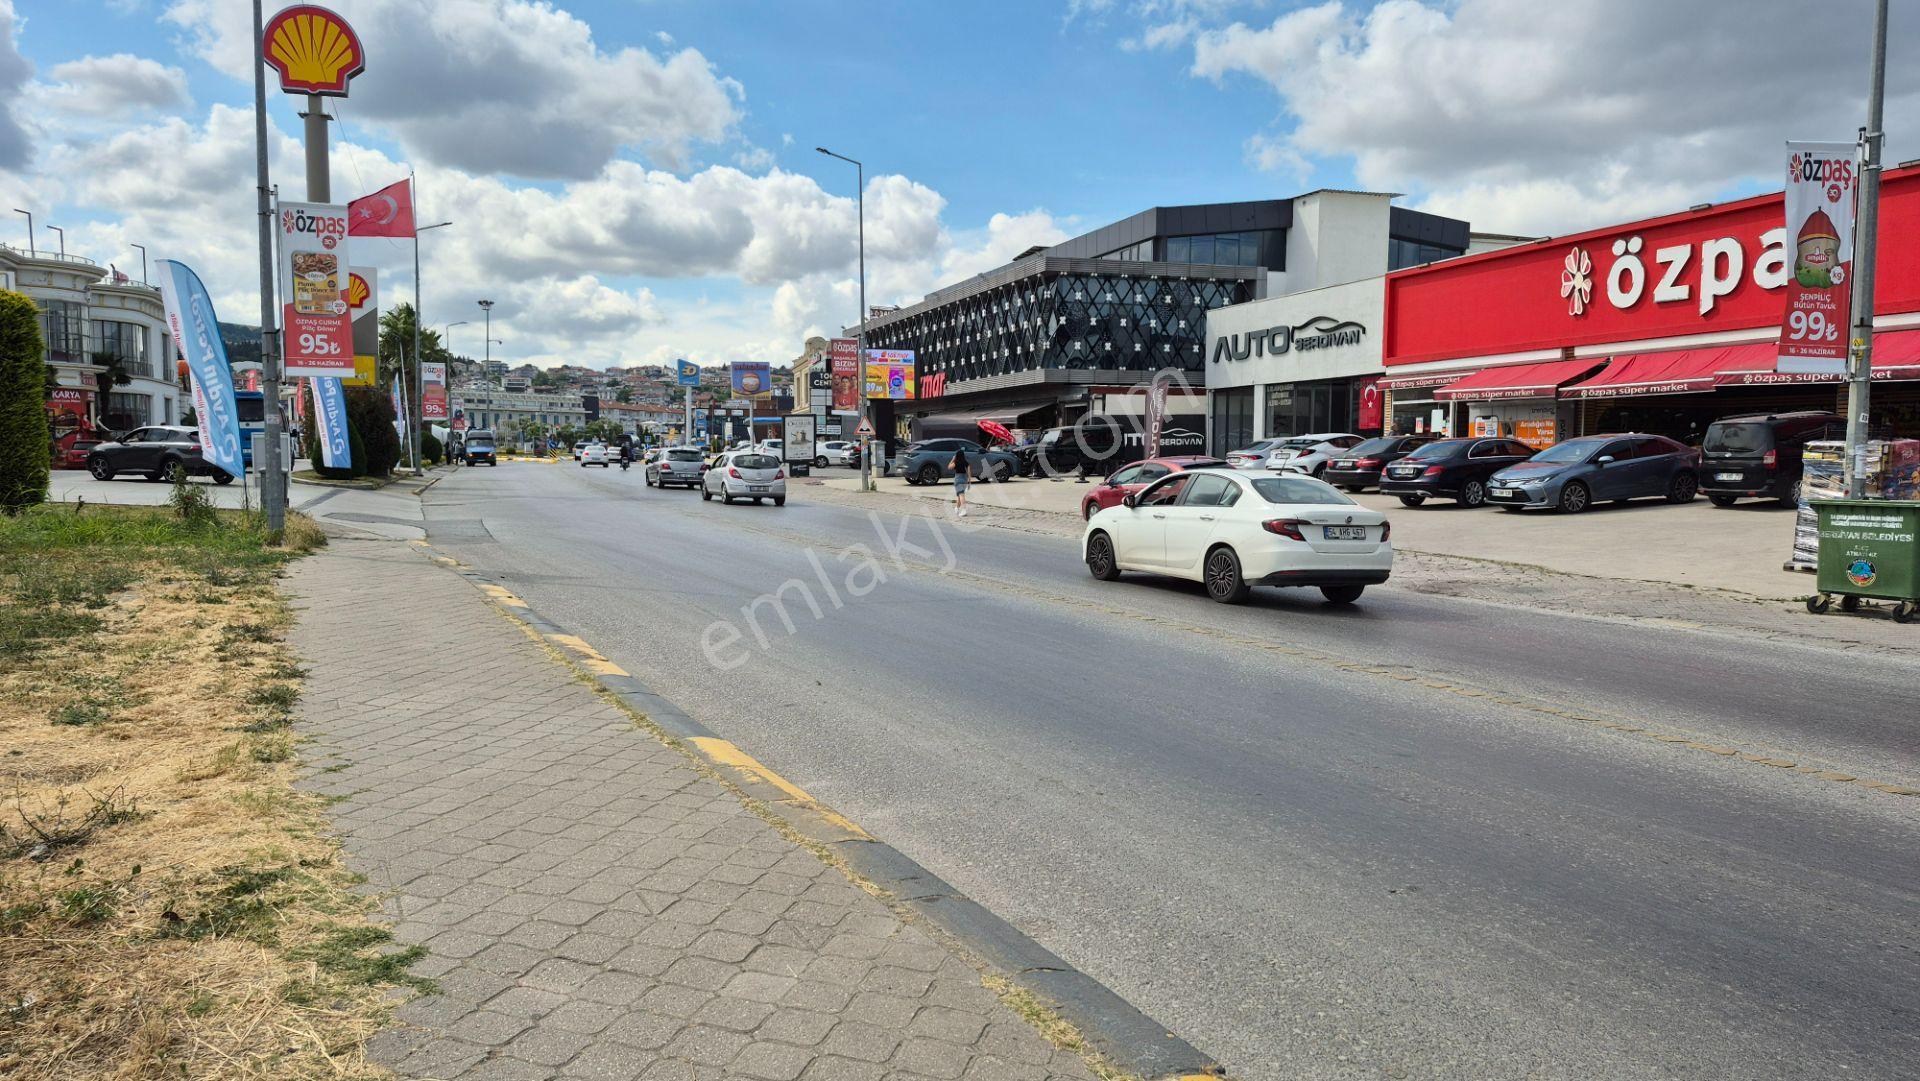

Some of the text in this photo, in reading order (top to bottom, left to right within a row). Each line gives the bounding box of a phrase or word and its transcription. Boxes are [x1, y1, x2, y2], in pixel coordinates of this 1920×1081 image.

[1803, 152, 1851, 190] özpaş
[295, 209, 346, 240] özpaş
[1607, 227, 1788, 316] özpa
[1794, 301, 1815, 309] Bütün
[1213, 326, 1290, 364] AUTO
[1396, 376, 1460, 389] özpaş süper market
[1755, 372, 1792, 384] özpaş
[52, 390, 80, 399] KARYA
[1457, 388, 1535, 400] özpaş süper market
[1588, 383, 1688, 398] özpaş süper market
